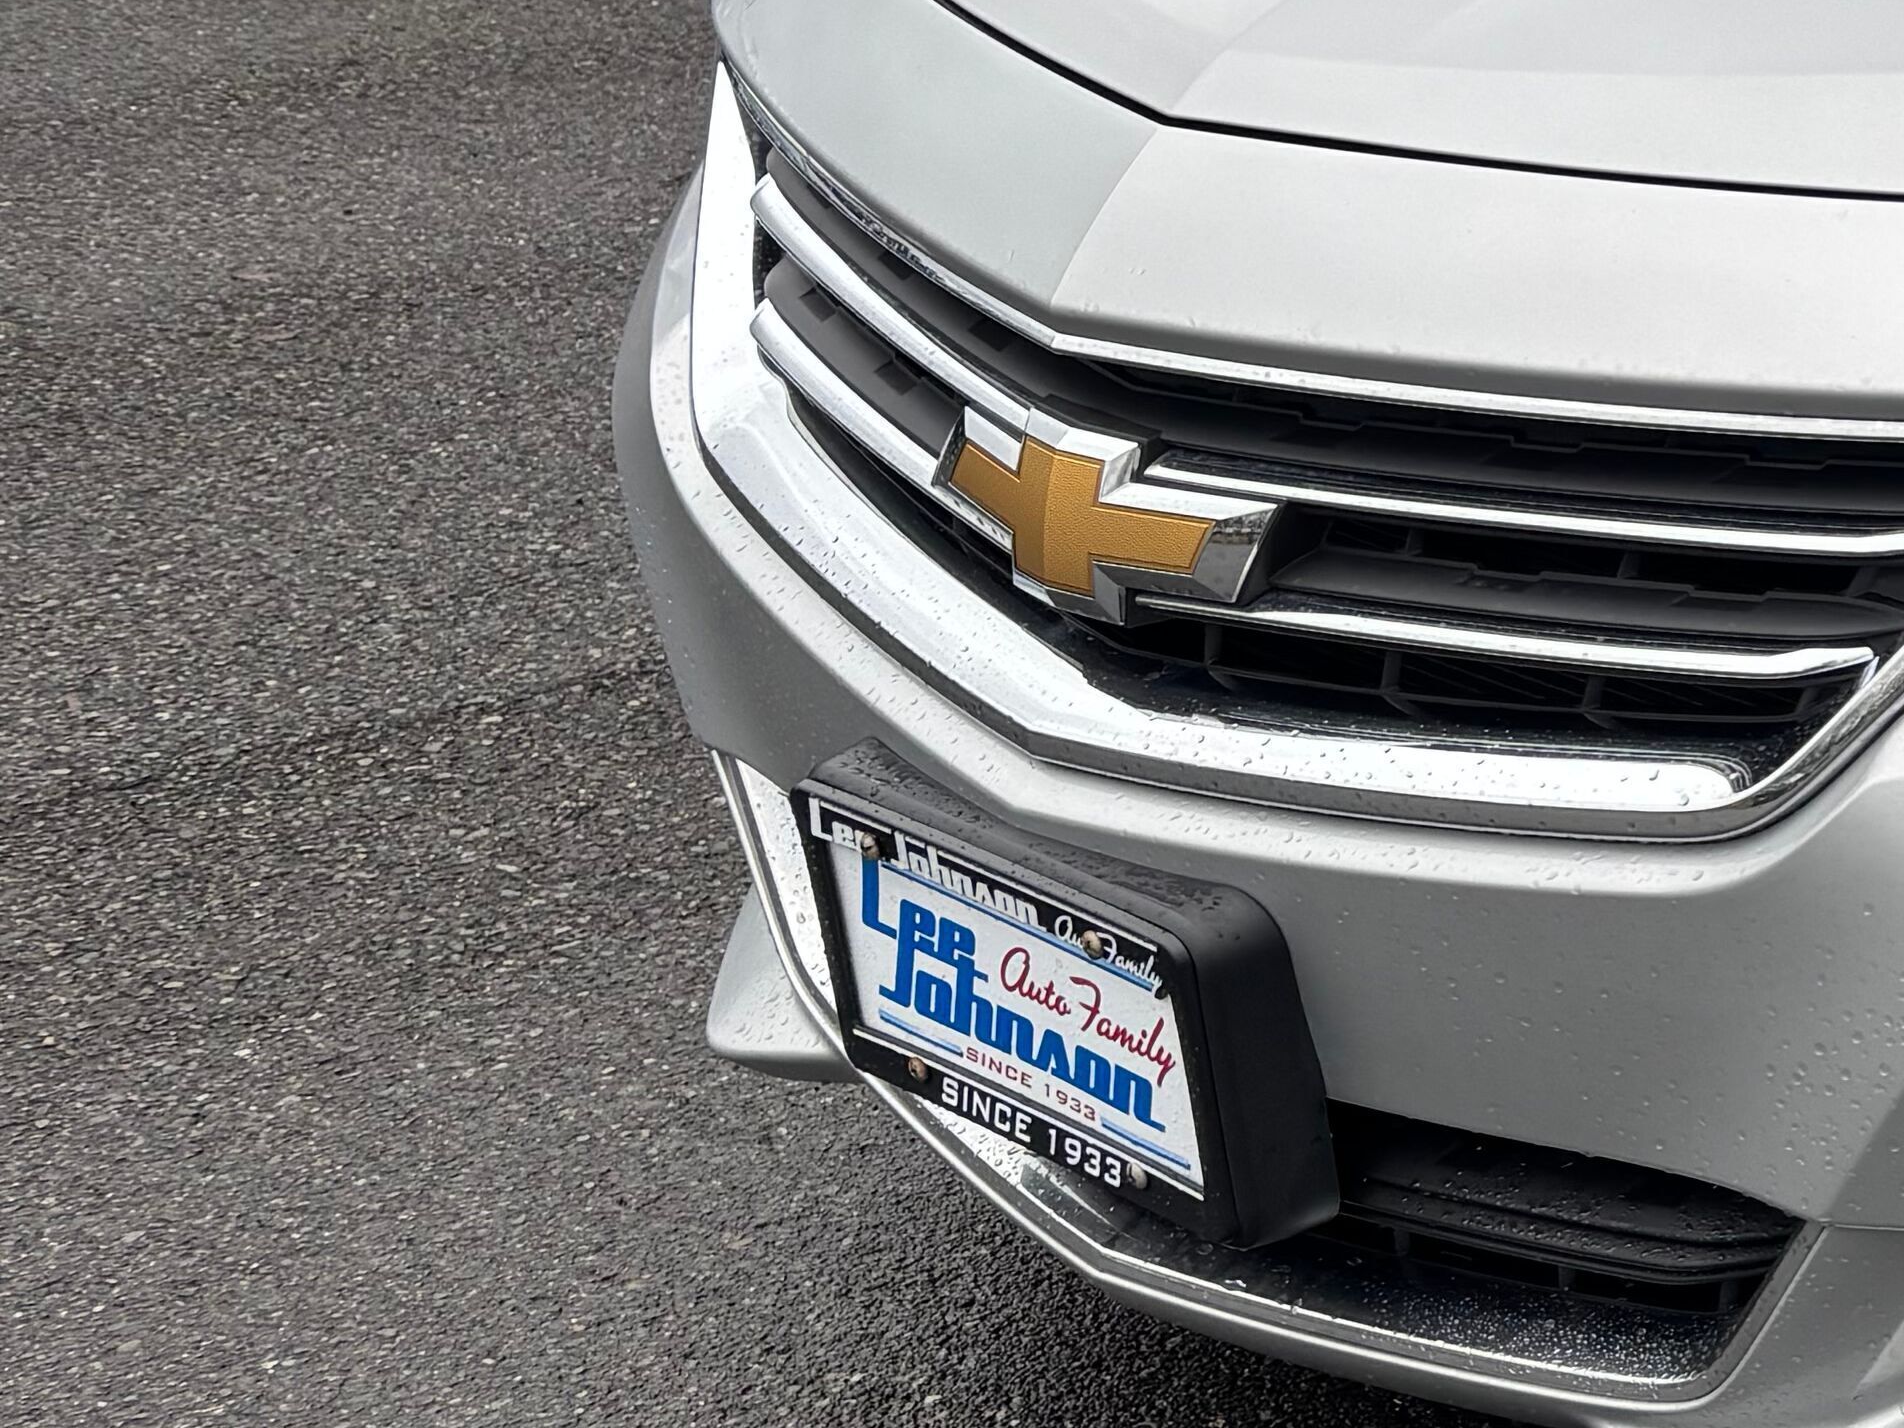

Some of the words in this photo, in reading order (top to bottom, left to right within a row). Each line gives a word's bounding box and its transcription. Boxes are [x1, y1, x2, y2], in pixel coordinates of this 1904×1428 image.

[861, 858, 988, 983] Lee
[1000, 946, 1071, 1017] Auto
[1069, 976, 1176, 1087] Family
[891, 829, 1048, 932] Johnson
[1097, 932, 1163, 995] Family
[879, 950, 1167, 1134] Johnson
[965, 1046, 1033, 1089] SINCE
[1044, 1083, 1097, 1122] 1933
[941, 1076, 1032, 1143] SINCE
[1048, 1128, 1122, 1189] 1933
